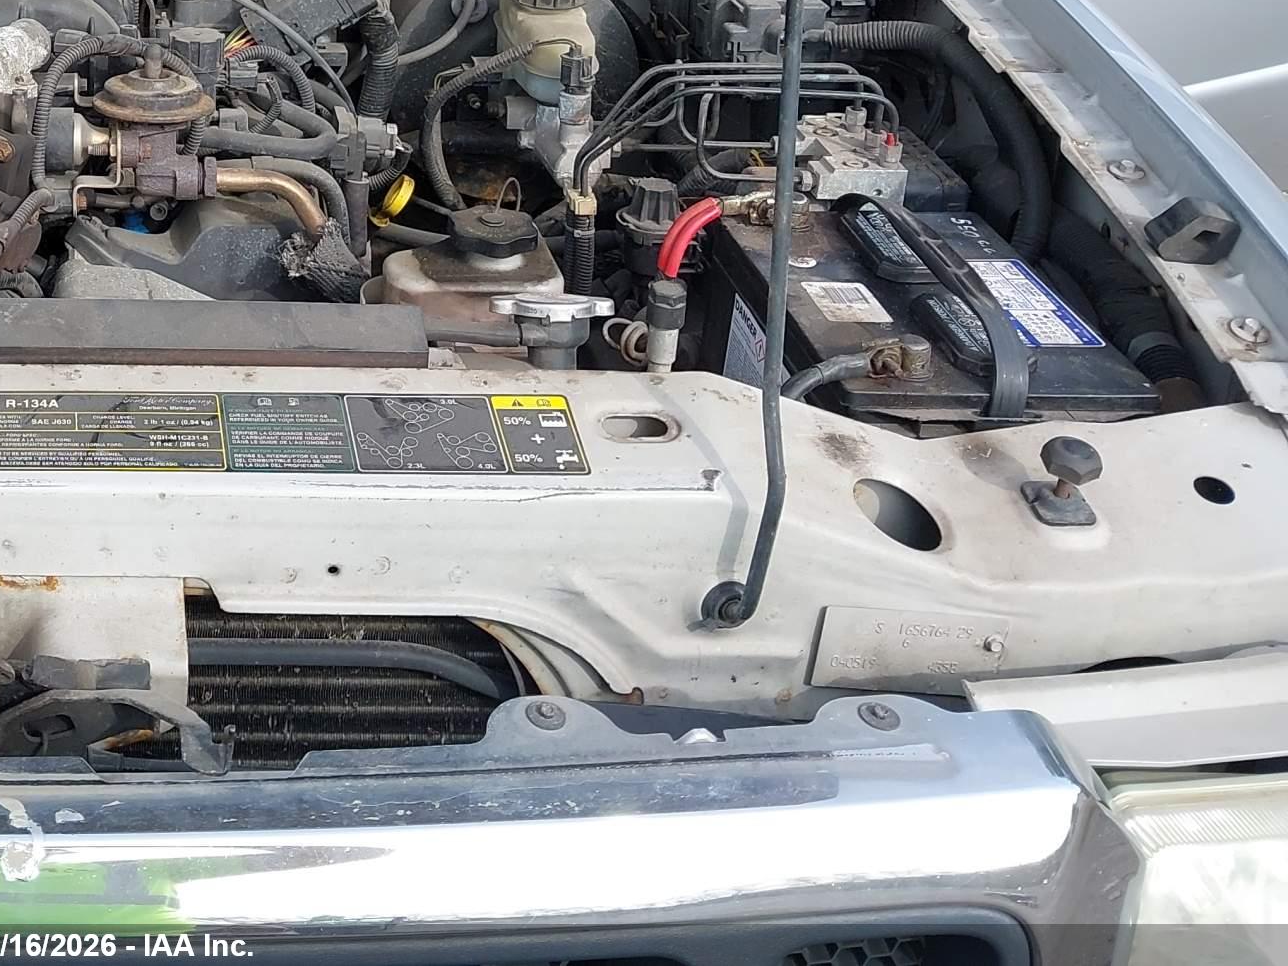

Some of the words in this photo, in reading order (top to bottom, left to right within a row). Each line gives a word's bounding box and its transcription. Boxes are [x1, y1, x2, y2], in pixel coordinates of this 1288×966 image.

[735, 298, 757, 339] DANGER
[6, 399, 59, 408] R-134A
[503, 416, 531, 425] 50%
[514, 454, 543, 463] 50%
